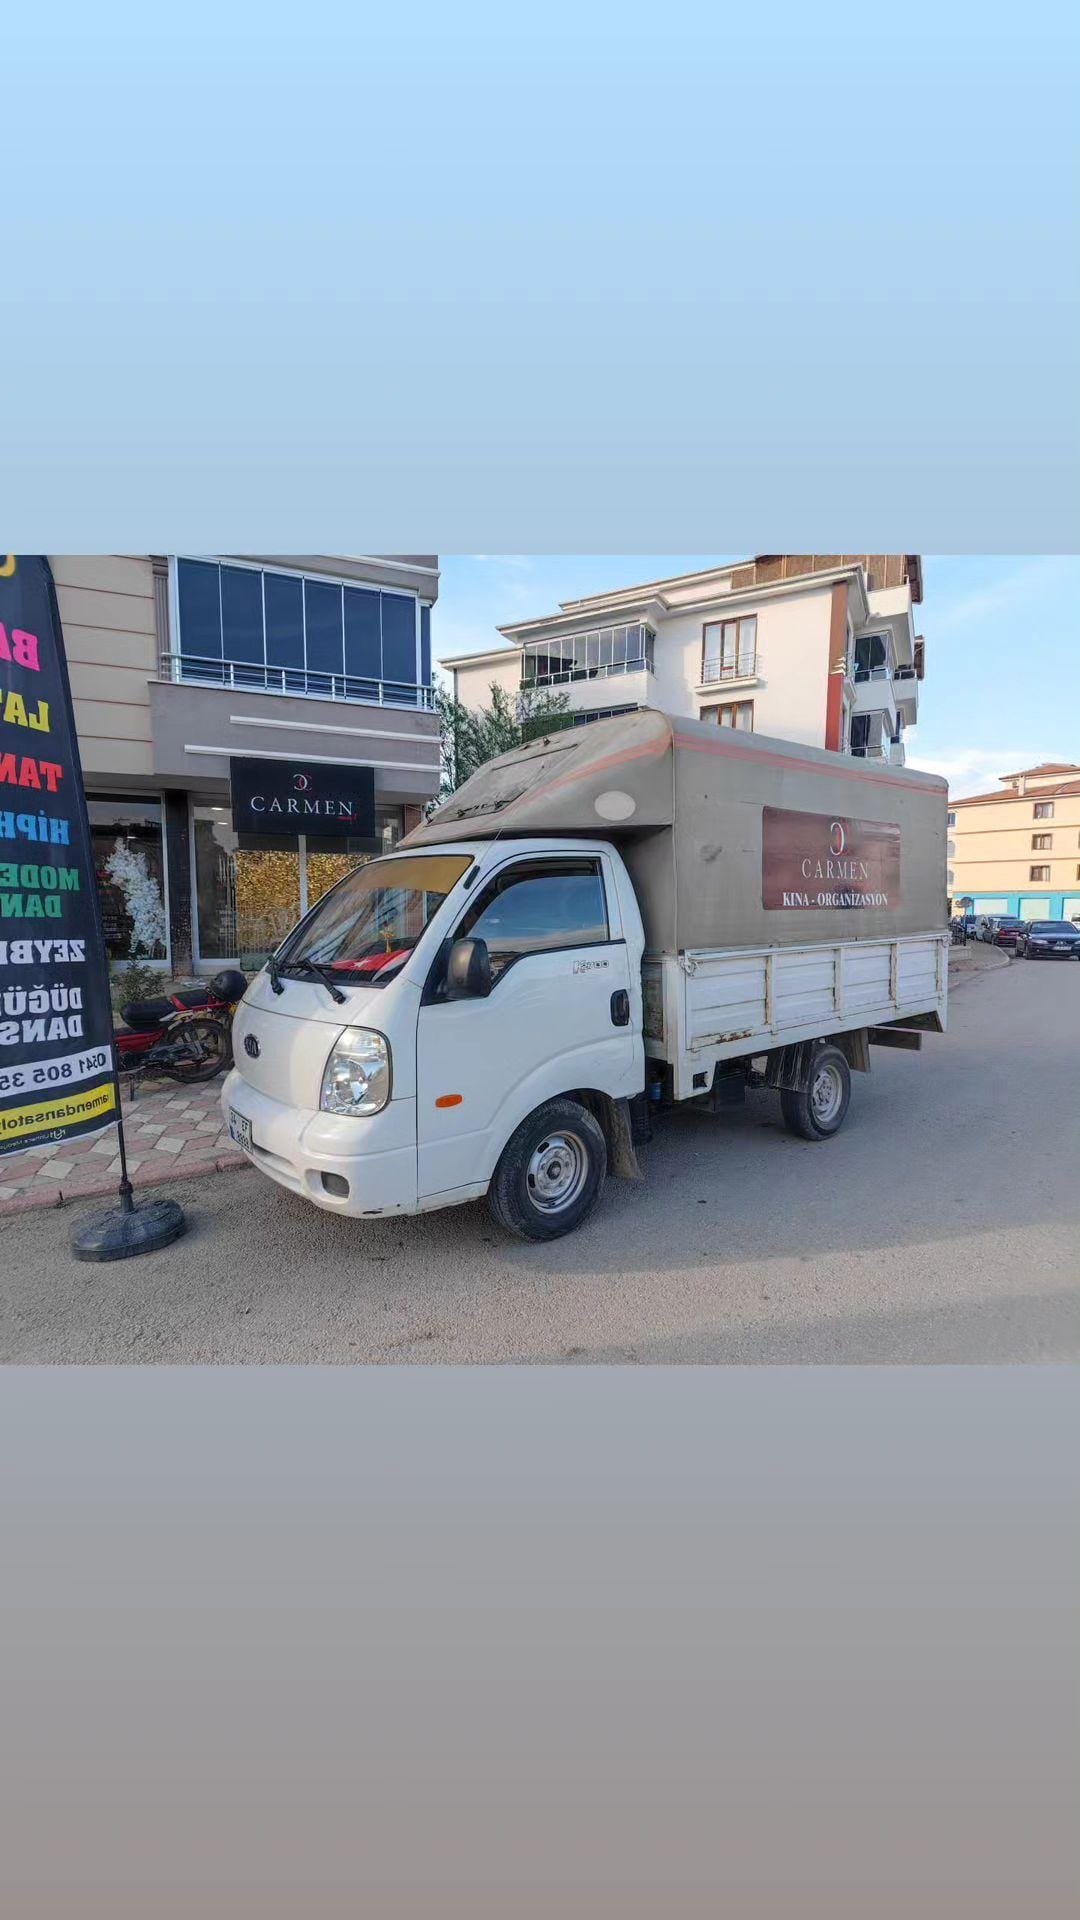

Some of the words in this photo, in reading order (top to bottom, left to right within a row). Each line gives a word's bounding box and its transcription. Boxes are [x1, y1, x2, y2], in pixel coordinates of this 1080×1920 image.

[251, 796, 353, 816] CARMEN
[801, 858, 869, 880] CARMEN
[783, 892, 809, 907] KINA
[817, 889, 889, 907] ORGANİZASYON
